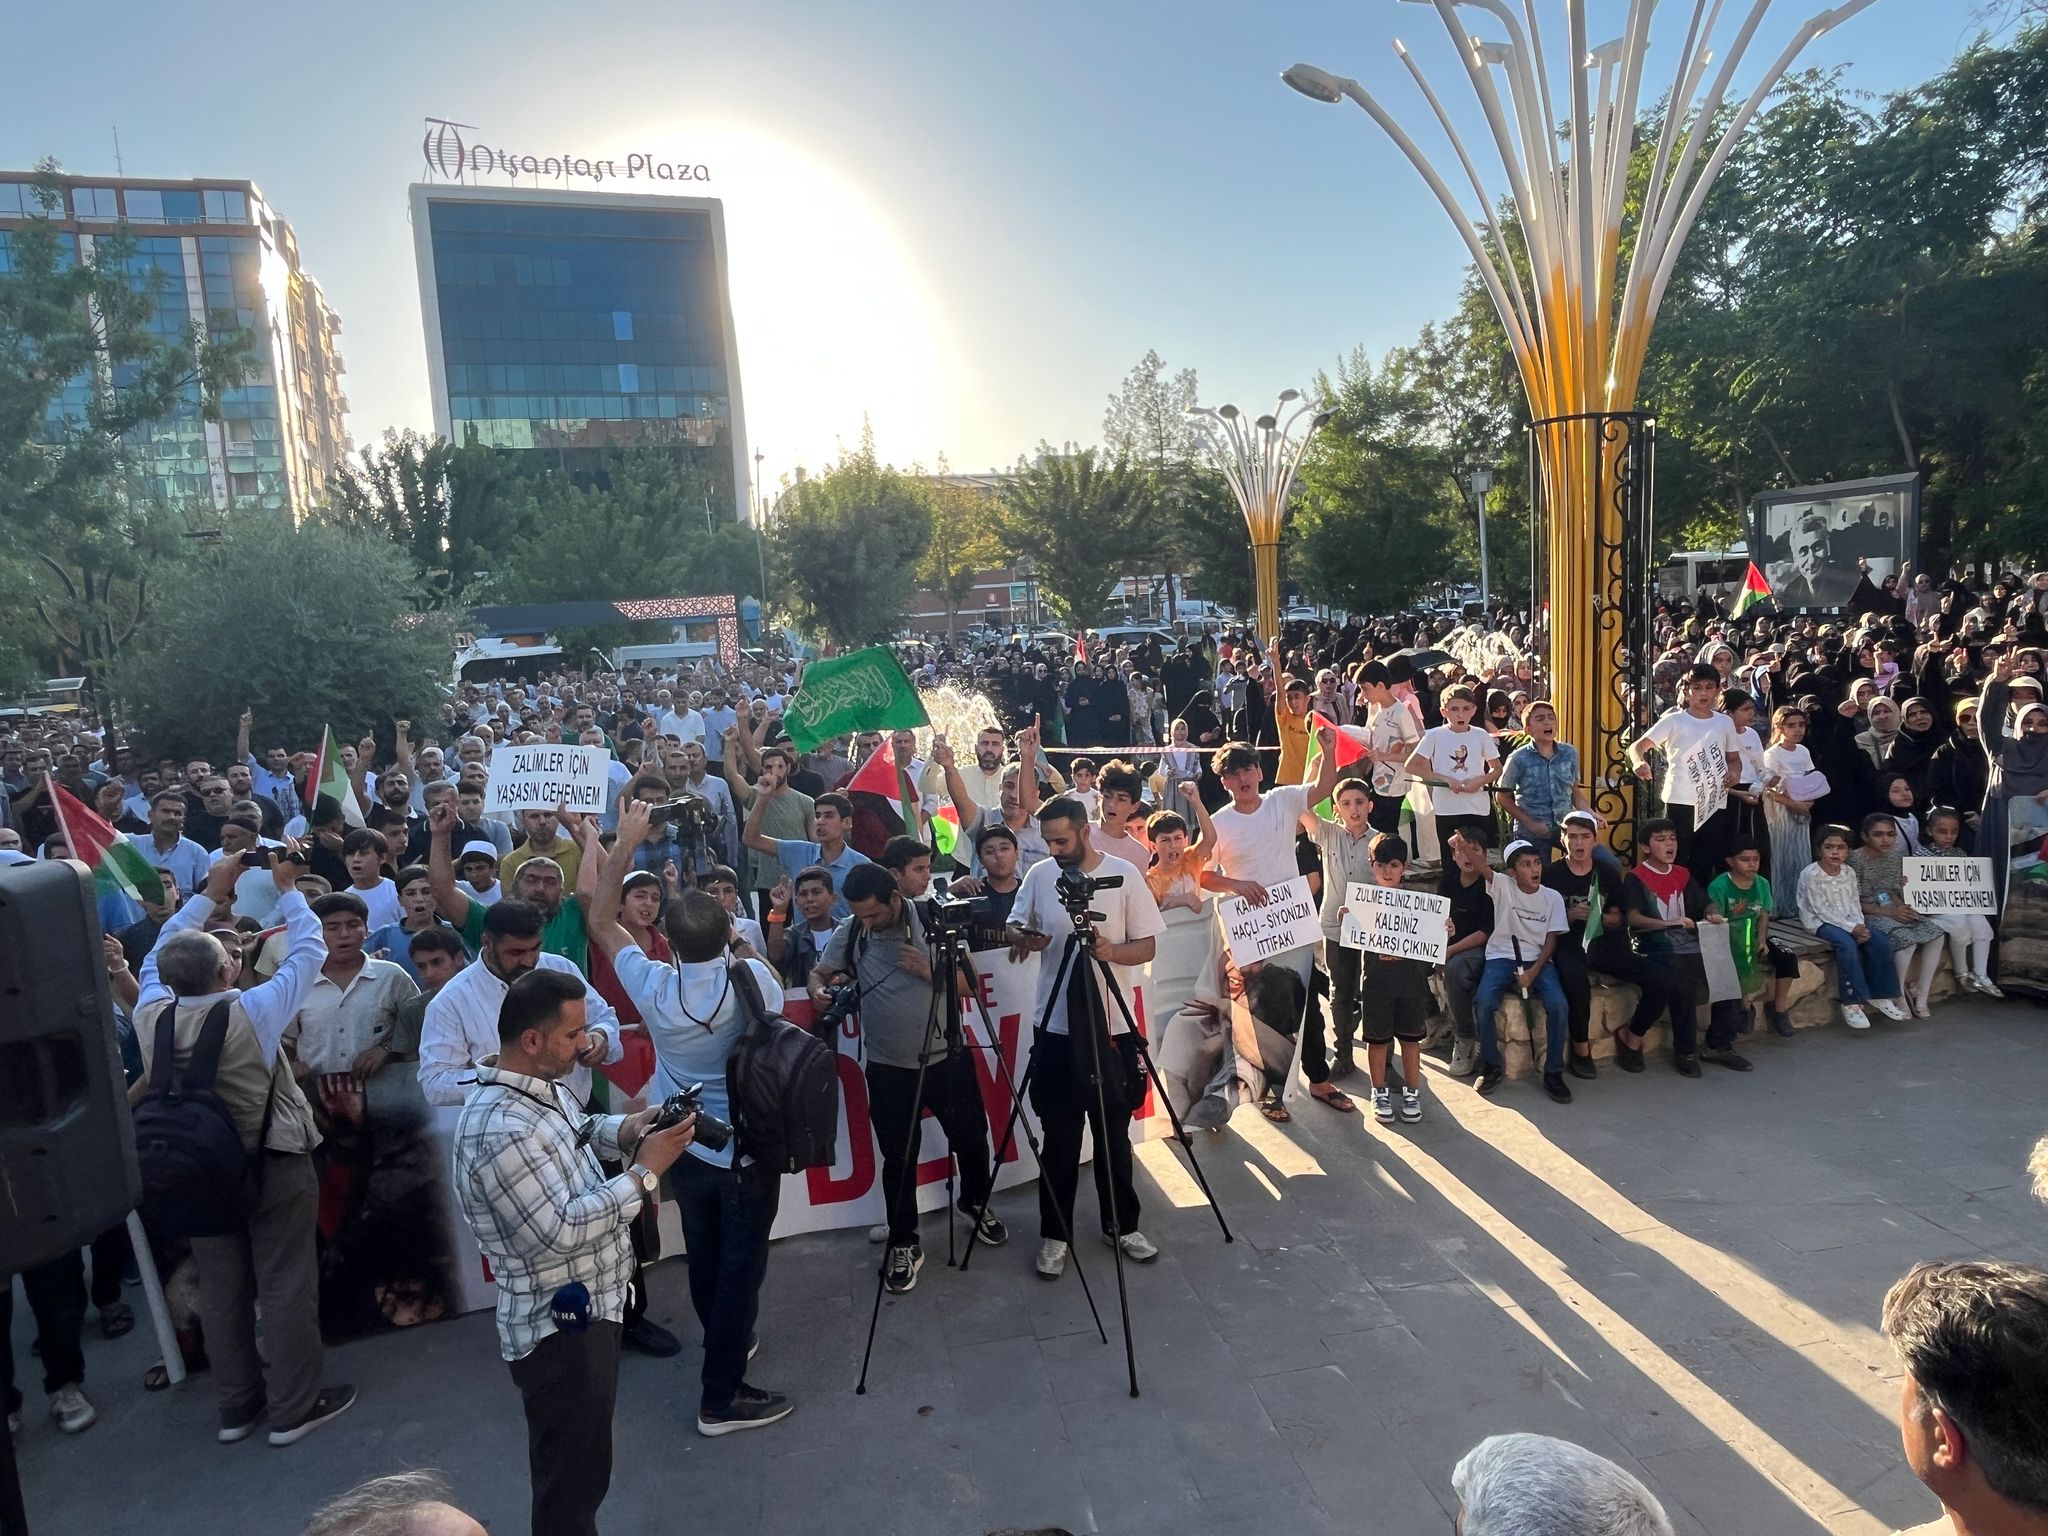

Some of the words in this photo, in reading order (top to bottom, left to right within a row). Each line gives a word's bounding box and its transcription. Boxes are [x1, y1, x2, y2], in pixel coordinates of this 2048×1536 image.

[626, 153, 711, 182] Plaza
[512, 749, 564, 774] ZALİMLER
[568, 749, 590, 779] İÇİN
[497, 782, 540, 808] YAŞASIN
[542, 782, 601, 806] CEHENNEM
[1920, 861, 1960, 882] ZALİMLER
[1963, 861, 1981, 886] İÇİN
[1355, 887, 1384, 905] ZULME
[1414, 894, 1442, 914] DİLİNİZ
[1911, 891, 1948, 912] YAŞASIN
[1949, 891, 1995, 908] CEHENNEM
[1231, 919, 1260, 941] HAÇLI
[1266, 902, 1311, 929] SİYONİZM
[1374, 912, 1419, 935] KALBİNİZ
[1255, 931, 1295, 956] İTTİFAKI
[1350, 926, 1367, 945] İLE
[1368, 933, 1401, 953] KARŞI
[1402, 939, 1440, 958] ÇIKINIZ
